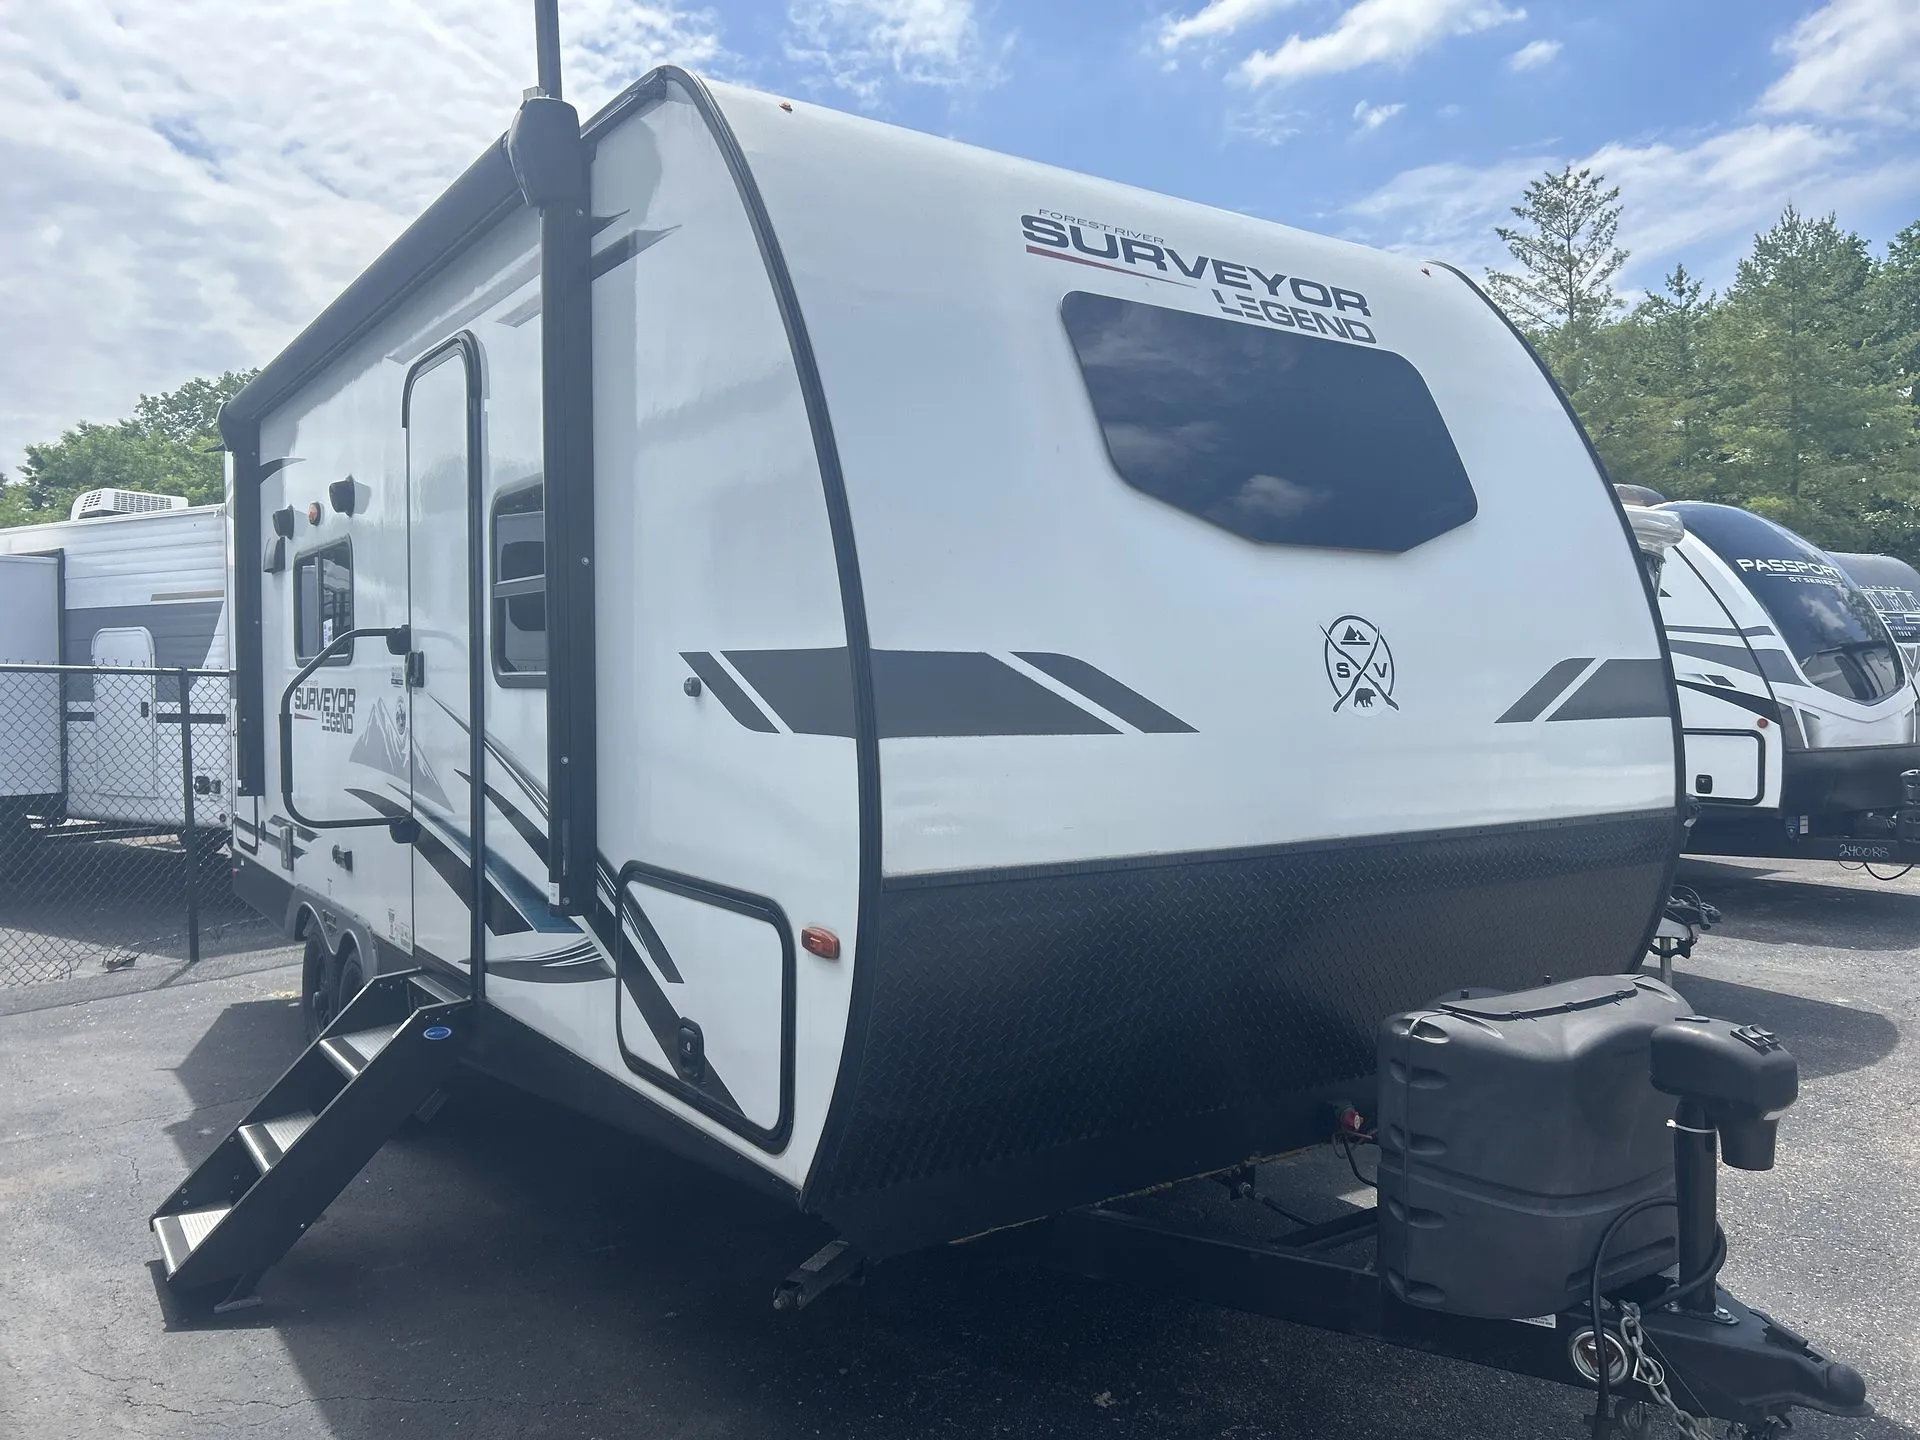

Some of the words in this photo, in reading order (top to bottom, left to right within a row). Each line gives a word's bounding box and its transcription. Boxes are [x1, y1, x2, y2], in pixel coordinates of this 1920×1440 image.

[1038, 208, 1111, 231] FOREST
[1114, 226, 1165, 244] RIVER
[1020, 214, 1372, 317] SURVEYOR
[1211, 288, 1377, 344] LEGEND
[1735, 559, 1842, 579] PASSPORT
[1336, 662, 1350, 678] S
[1373, 662, 1387, 678] V
[294, 687, 356, 714] SURVEYOR
[322, 711, 354, 735] LEGEND
